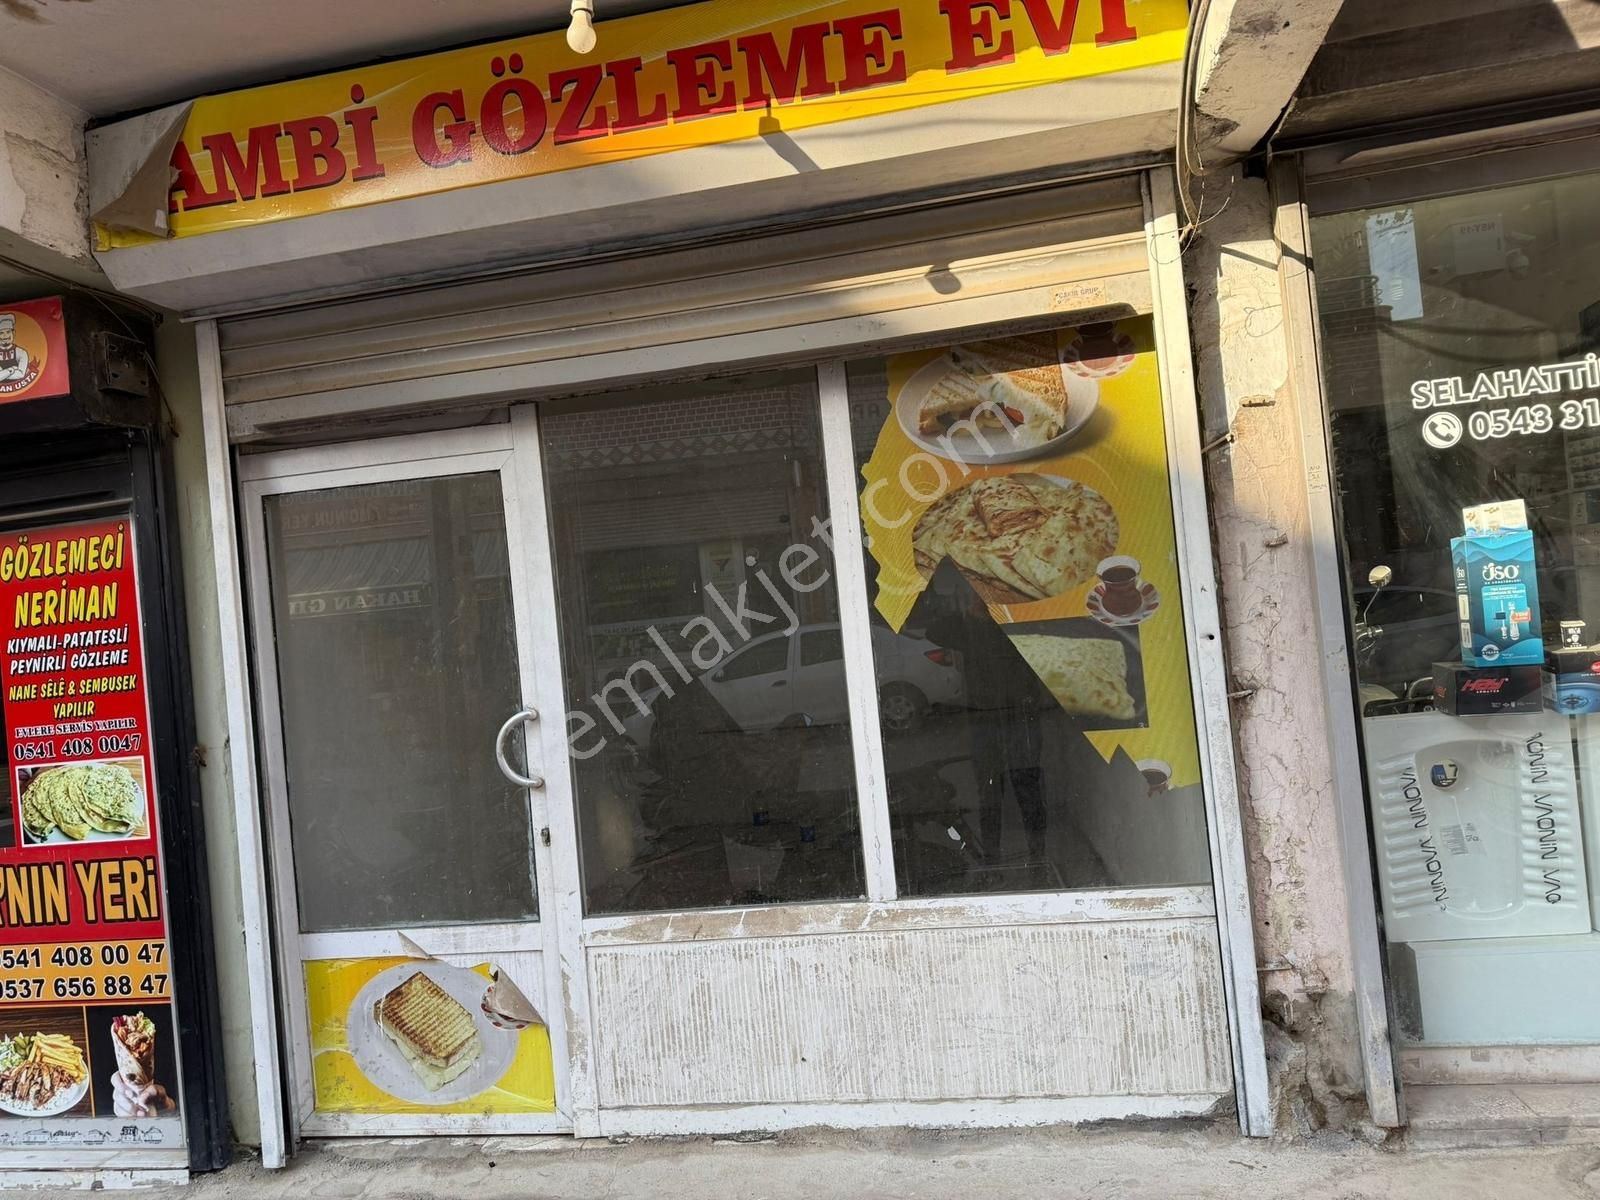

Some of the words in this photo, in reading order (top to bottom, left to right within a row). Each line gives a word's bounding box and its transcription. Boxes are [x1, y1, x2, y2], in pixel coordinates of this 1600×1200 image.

[411, 11, 907, 170] GÖZLEME
[15, 372, 37, 389] USTA
[1411, 353, 1600, 409] SELAHATTİ
[1468, 403, 1553, 441] 0543
[0, 523, 125, 582] GÖZLEMECİ
[14, 579, 118, 629] NERİMAN
[7, 623, 129, 655] KIYMALI-PATATESLİ
[10, 651, 67, 676] PEYNİRLİ
[70, 649, 129, 670] GÖZLEME
[9, 684, 37, 701] NANE
[67, 680, 76, 695] &
[79, 674, 137, 695] SEMBUSEK
[53, 700, 96, 719] YAPILIR
[15, 725, 54, 739] EVLERE
[55, 719, 93, 734] SERVİS
[95, 717, 137, 730] YAPILIR
[14, 741, 55, 760] 0541
[61, 738, 94, 756] 408
[98, 733, 142, 753] 0047
[0, 861, 70, 927] NIN
[0, 947, 42, 970] 541
[51, 945, 94, 967] 408
[101, 944, 130, 966] 00
[137, 942, 166, 964] 47
[0, 977, 45, 1000] 537
[53, 976, 97, 998] 656
[104, 975, 132, 996] 88
[140, 973, 169, 995] 47
